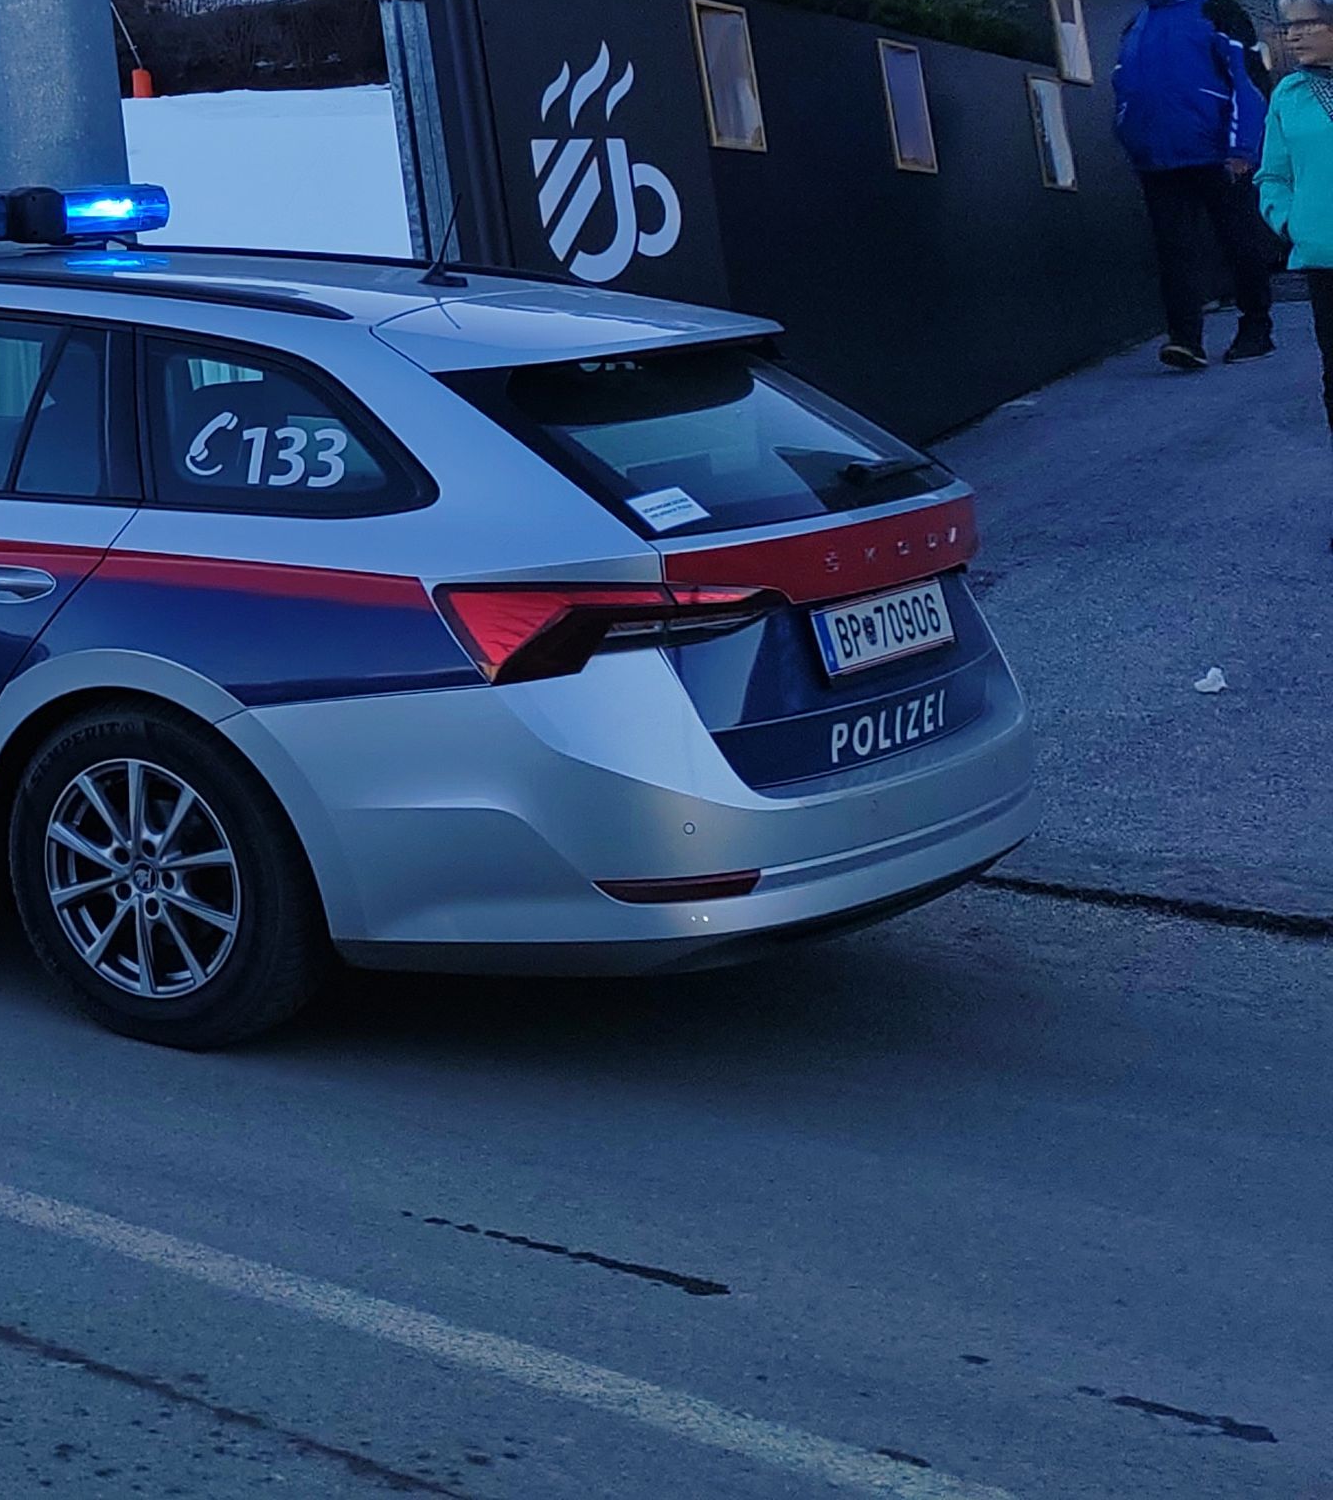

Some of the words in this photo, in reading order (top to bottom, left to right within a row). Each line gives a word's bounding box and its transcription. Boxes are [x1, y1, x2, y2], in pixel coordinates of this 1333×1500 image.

[242, 426, 348, 488] 133
[835, 613, 862, 660] BP
[874, 592, 941, 648] 70906
[831, 689, 945, 764] POLIZEI
